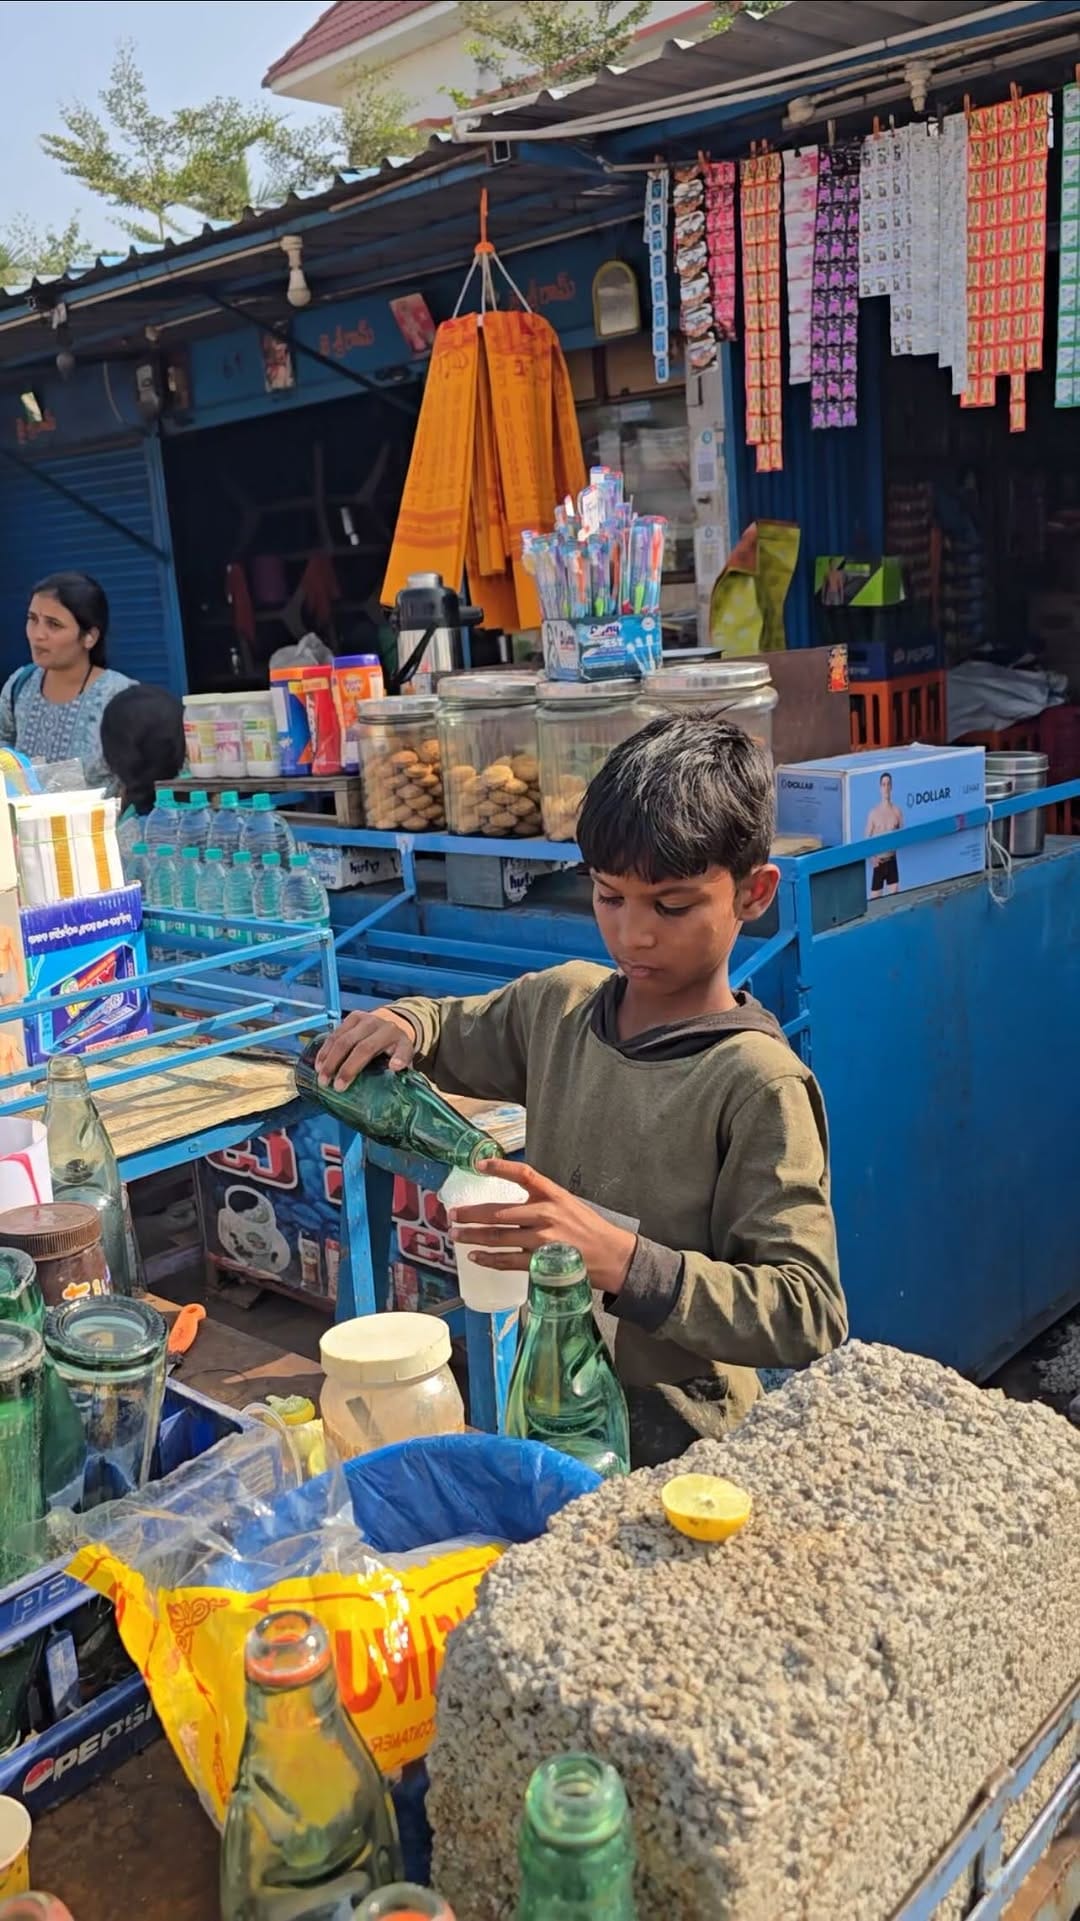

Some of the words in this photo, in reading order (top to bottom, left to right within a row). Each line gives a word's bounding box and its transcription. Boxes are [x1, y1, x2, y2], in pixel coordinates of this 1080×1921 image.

[787, 780, 814, 790] DOLLAR
[915, 787, 951, 805] DOLLAR
[53, 1703, 153, 1782] PEPSI
